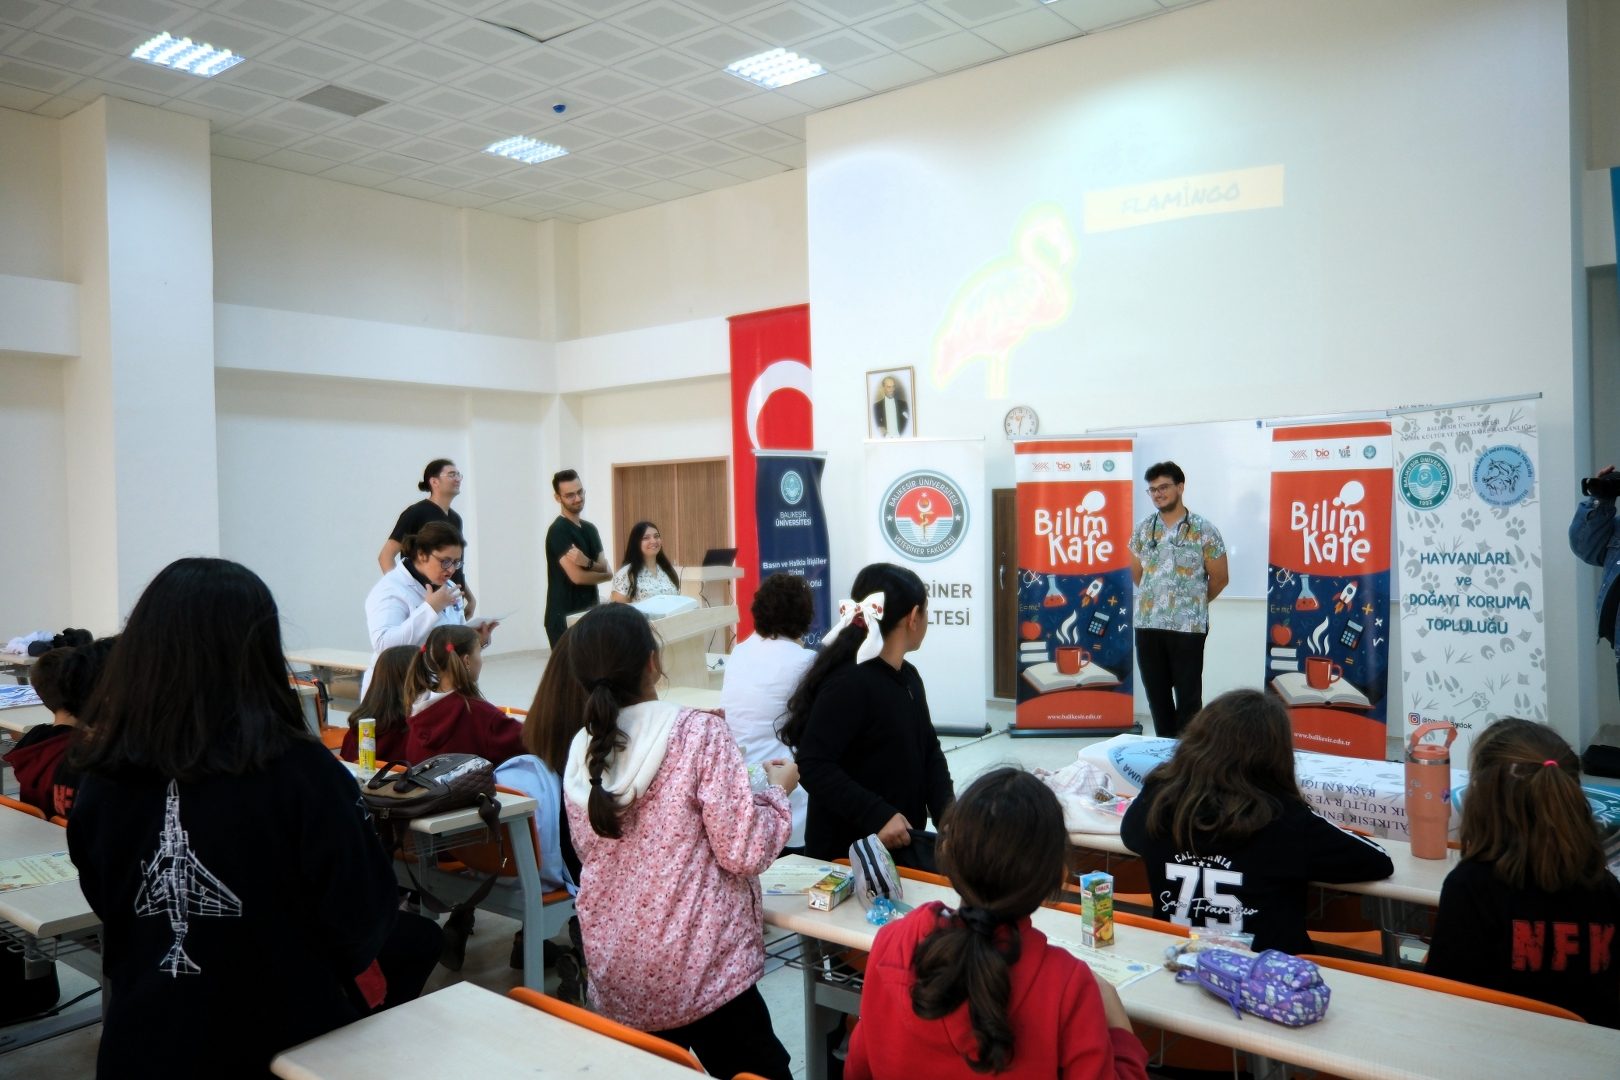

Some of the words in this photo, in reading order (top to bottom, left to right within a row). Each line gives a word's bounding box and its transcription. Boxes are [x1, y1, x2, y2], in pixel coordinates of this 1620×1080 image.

[1120, 181, 1240, 214] FLAMİNGO
[888, 480, 917, 507] BALIKESİR
[918, 477, 961, 506] ÜNİVERSİTESİ
[775, 517, 812, 527] ÜNİVERSİTESİ
[1034, 505, 1107, 537] Bilim
[1291, 497, 1365, 533] Bilim
[1048, 530, 1113, 566] Kafe
[1303, 525, 1371, 566] Kafe
[1420, 551, 1511, 565] HAYVANLARI
[924, 580, 972, 599] RİNER
[1456, 576, 1472, 586] ve
[1409, 590, 1460, 607] DOĞAYI
[1467, 594, 1530, 610] KORUMA
[1426, 617, 1508, 635] TOPLULUĞU
[1315, 795, 1330, 805] VE
[1335, 798, 1387, 813] KÜLTÜR
[1350, 812, 1409, 830] ALIKESİR
[1165, 862, 1243, 935] 75
